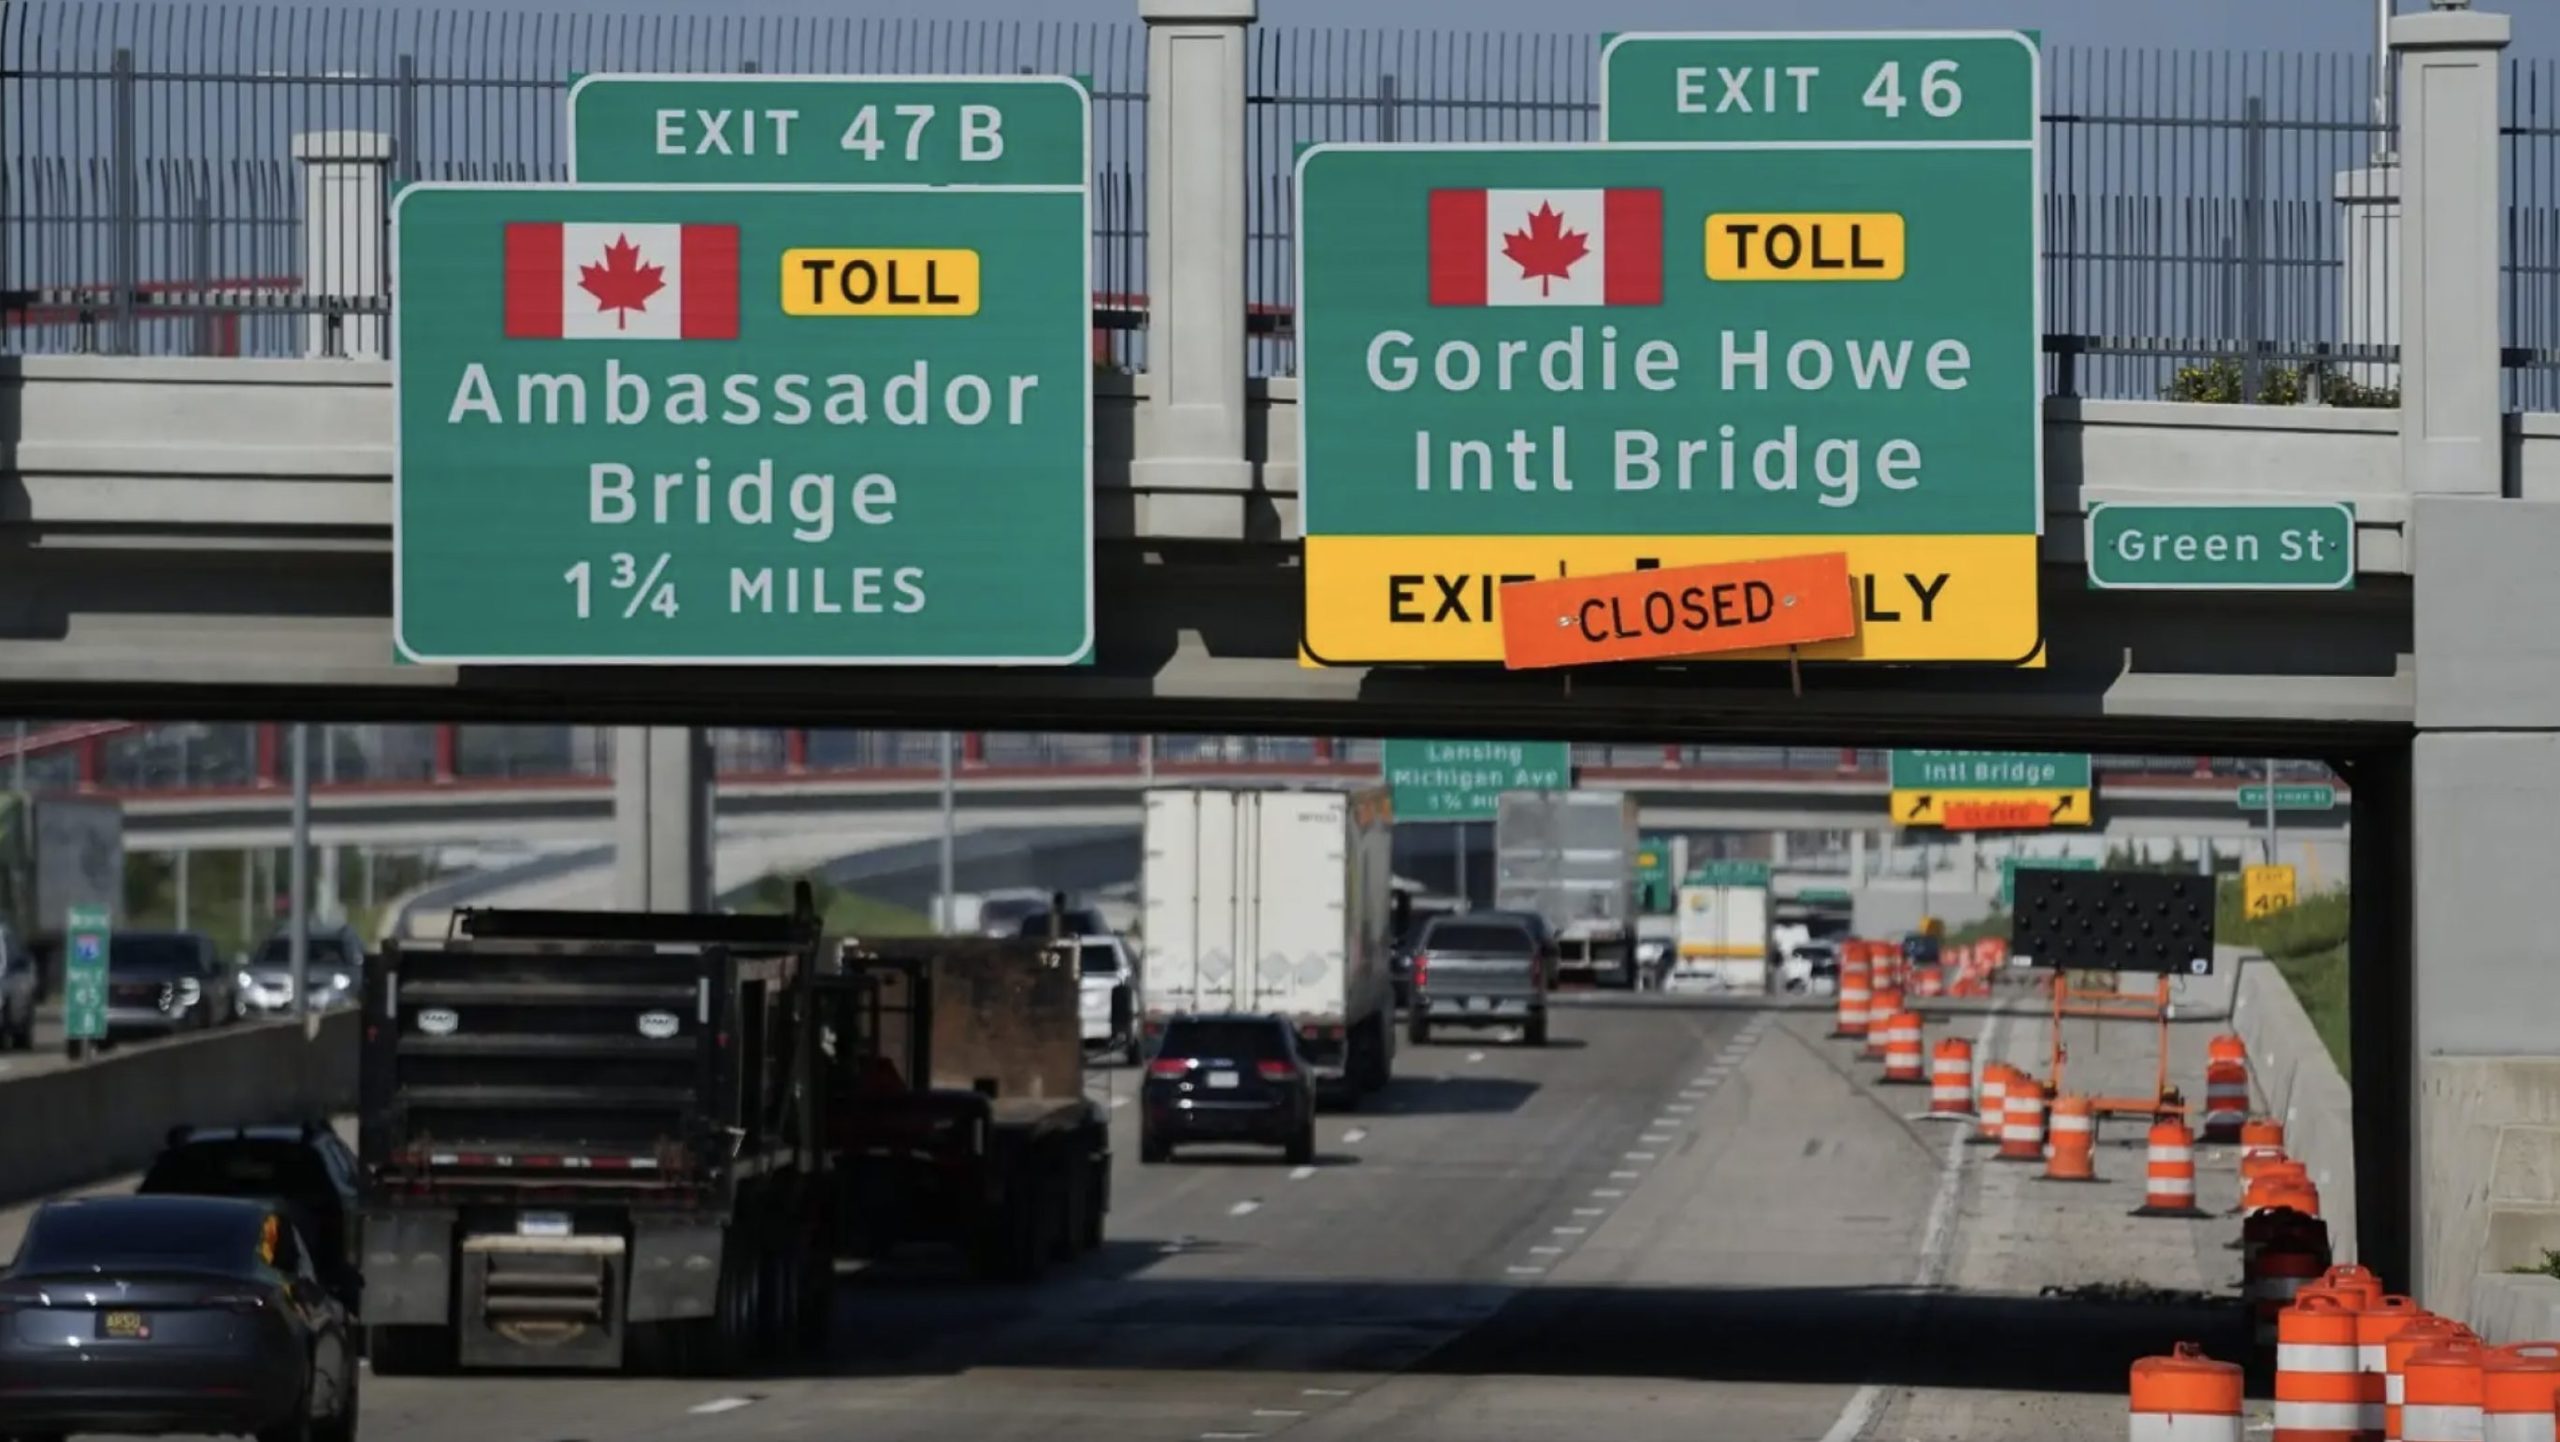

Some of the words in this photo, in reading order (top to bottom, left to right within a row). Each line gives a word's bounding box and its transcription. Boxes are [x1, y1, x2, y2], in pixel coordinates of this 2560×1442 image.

[1677, 66, 1819, 113] EXIT
[1862, 59, 1962, 118] 46
[656, 109, 799, 155] EXIT
[1725, 223, 1885, 270] TOLL
[802, 259, 960, 305] TOLL
[1366, 325, 1679, 392] Gordie
[1721, 330, 1971, 391] Howe
[448, 359, 1039, 426] Ambassador
[1416, 425, 1573, 492] Intl
[1615, 424, 1921, 508] Bridge
[590, 457, 897, 542] Bridge
[2118, 529, 2258, 561] Green
[2280, 529, 2324, 561] St
[730, 567, 926, 613] MILES
[1389, 574, 1537, 623] EXI
[1578, 580, 1775, 642] CLOSED
[1427, 743, 1522, 767] Lansing
[1924, 762, 1966, 781] Intl
[1974, 762, 2056, 787] Bridge
[1394, 768, 1503, 791] Michigan
[1515, 769, 1559, 786] Ave
